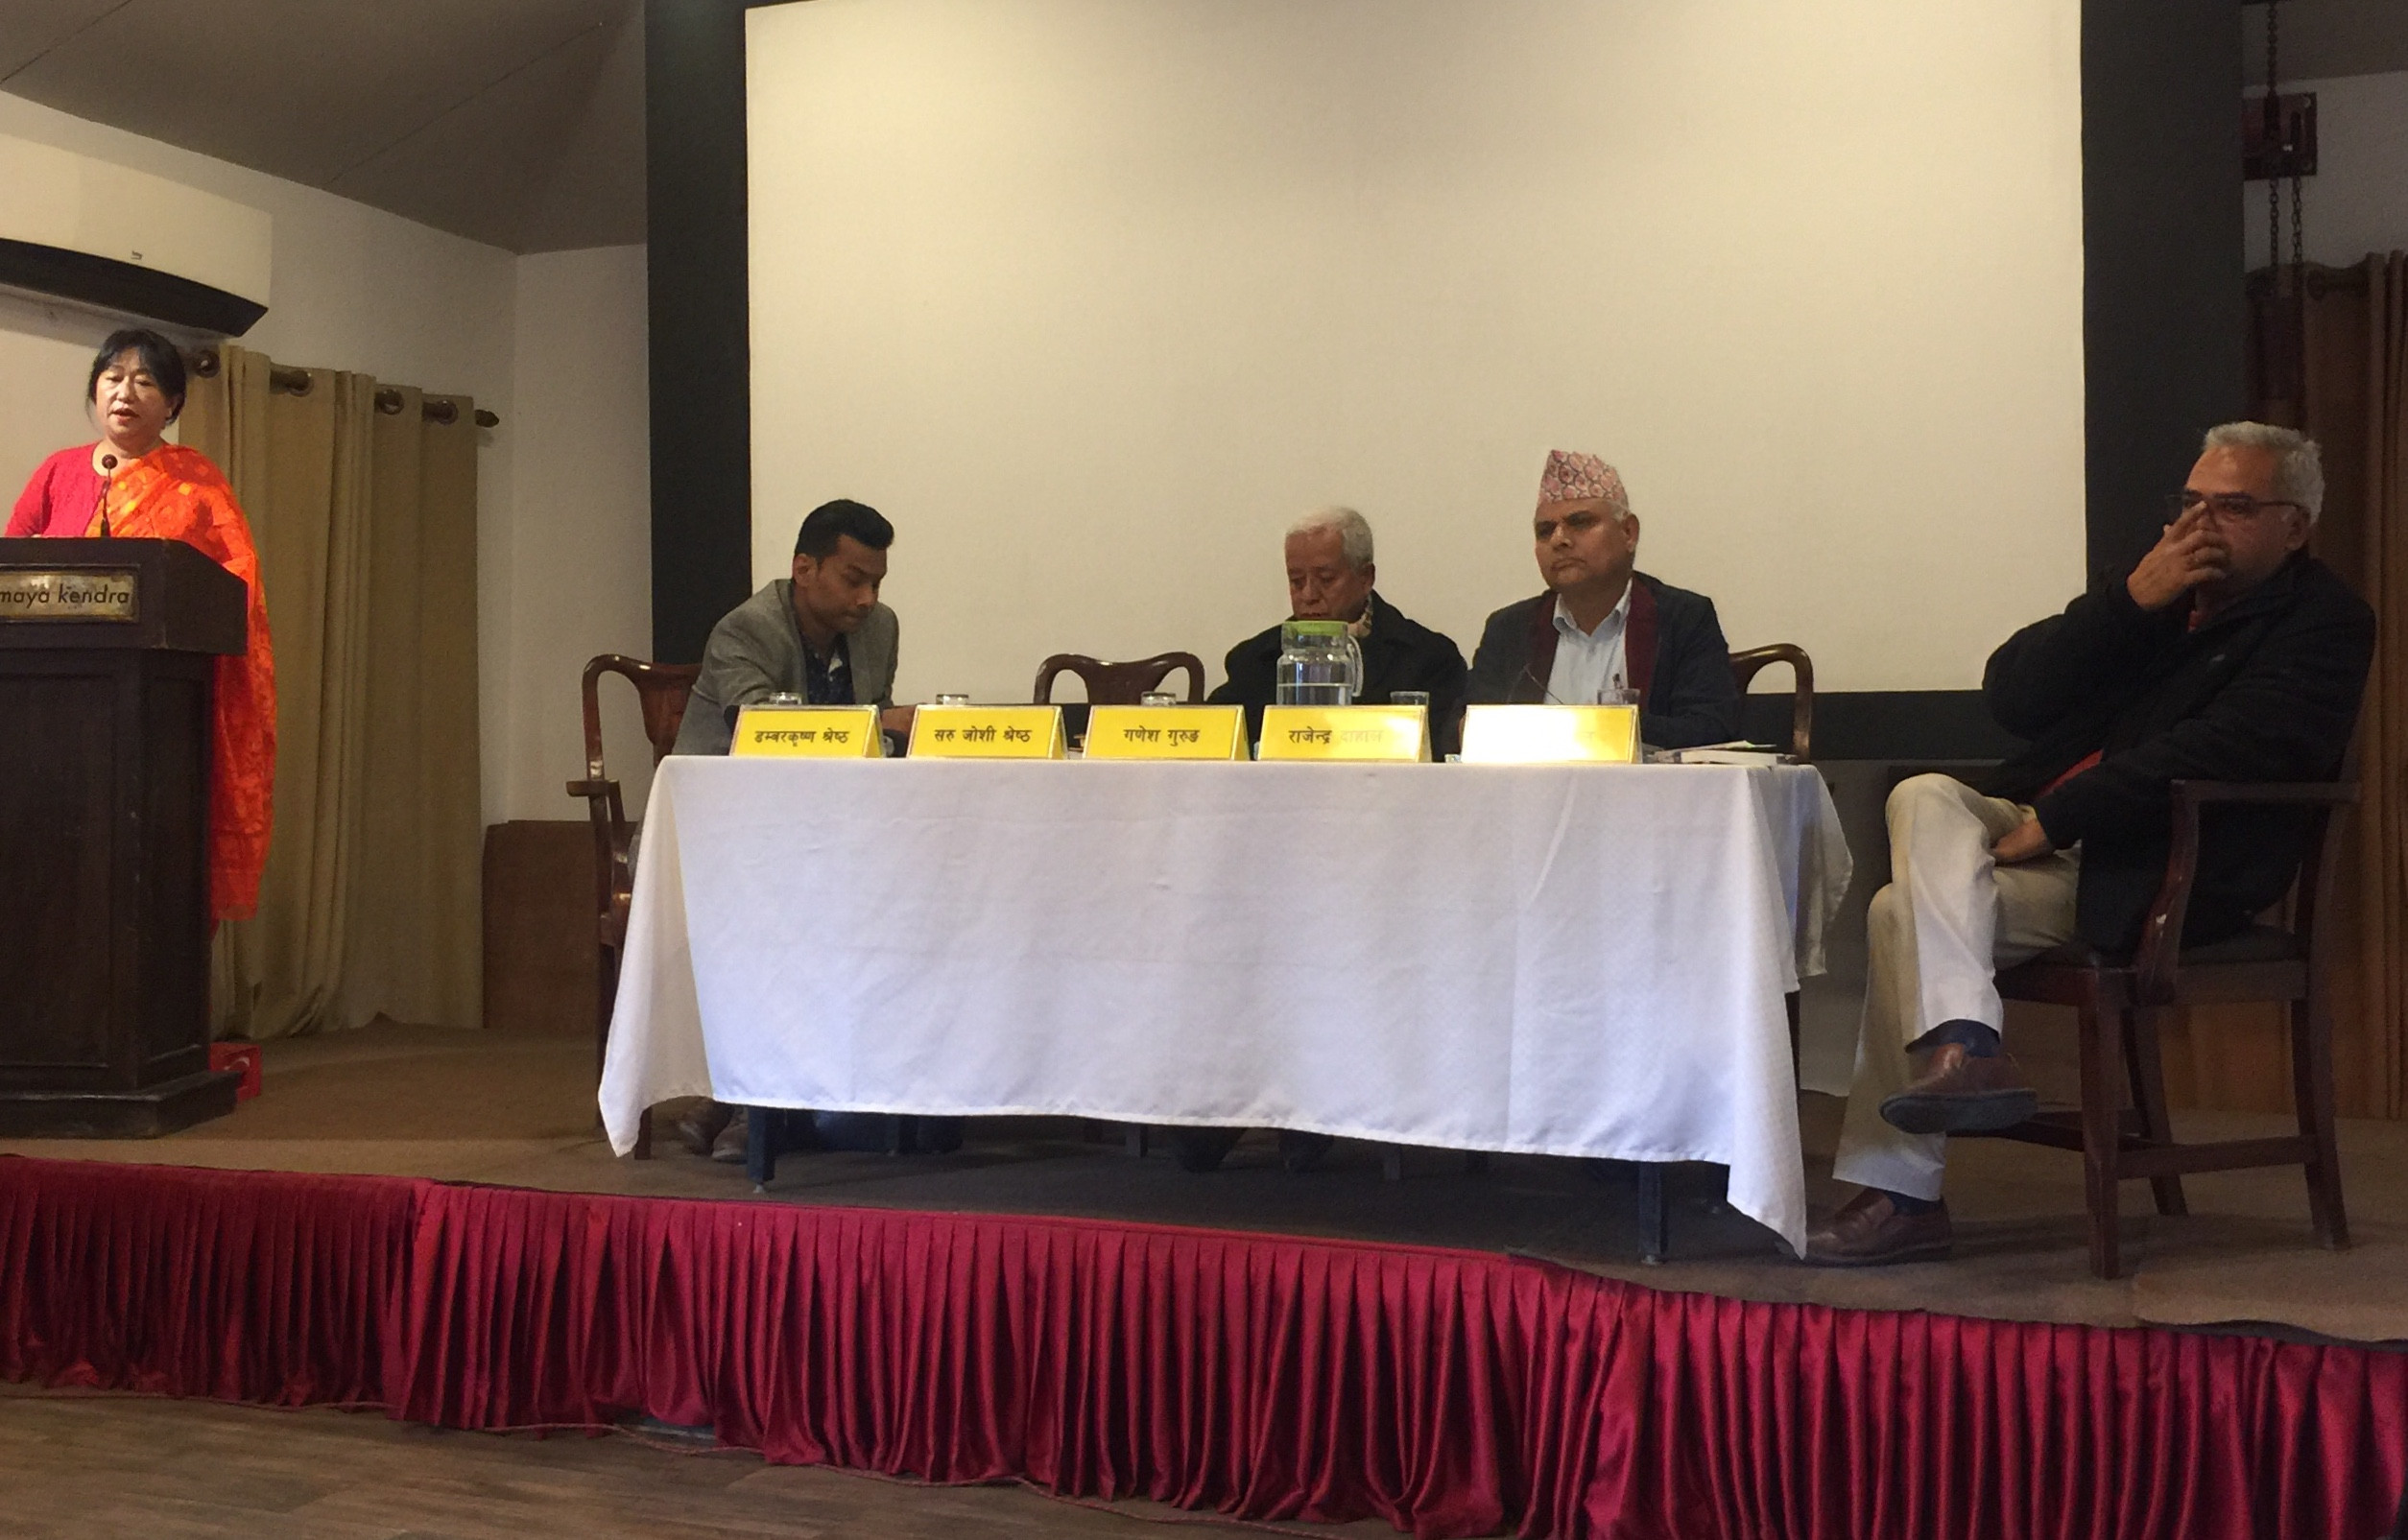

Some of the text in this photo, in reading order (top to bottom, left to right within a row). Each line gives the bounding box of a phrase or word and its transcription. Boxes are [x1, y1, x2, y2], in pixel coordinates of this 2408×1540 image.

[58, 582, 131, 604] kendra
[934, 728, 957, 743] सरु
[962, 724, 997, 743] जोशी
[1123, 724, 1161, 743] गणेश
[1288, 725, 1332, 745] राजेन्द्र
